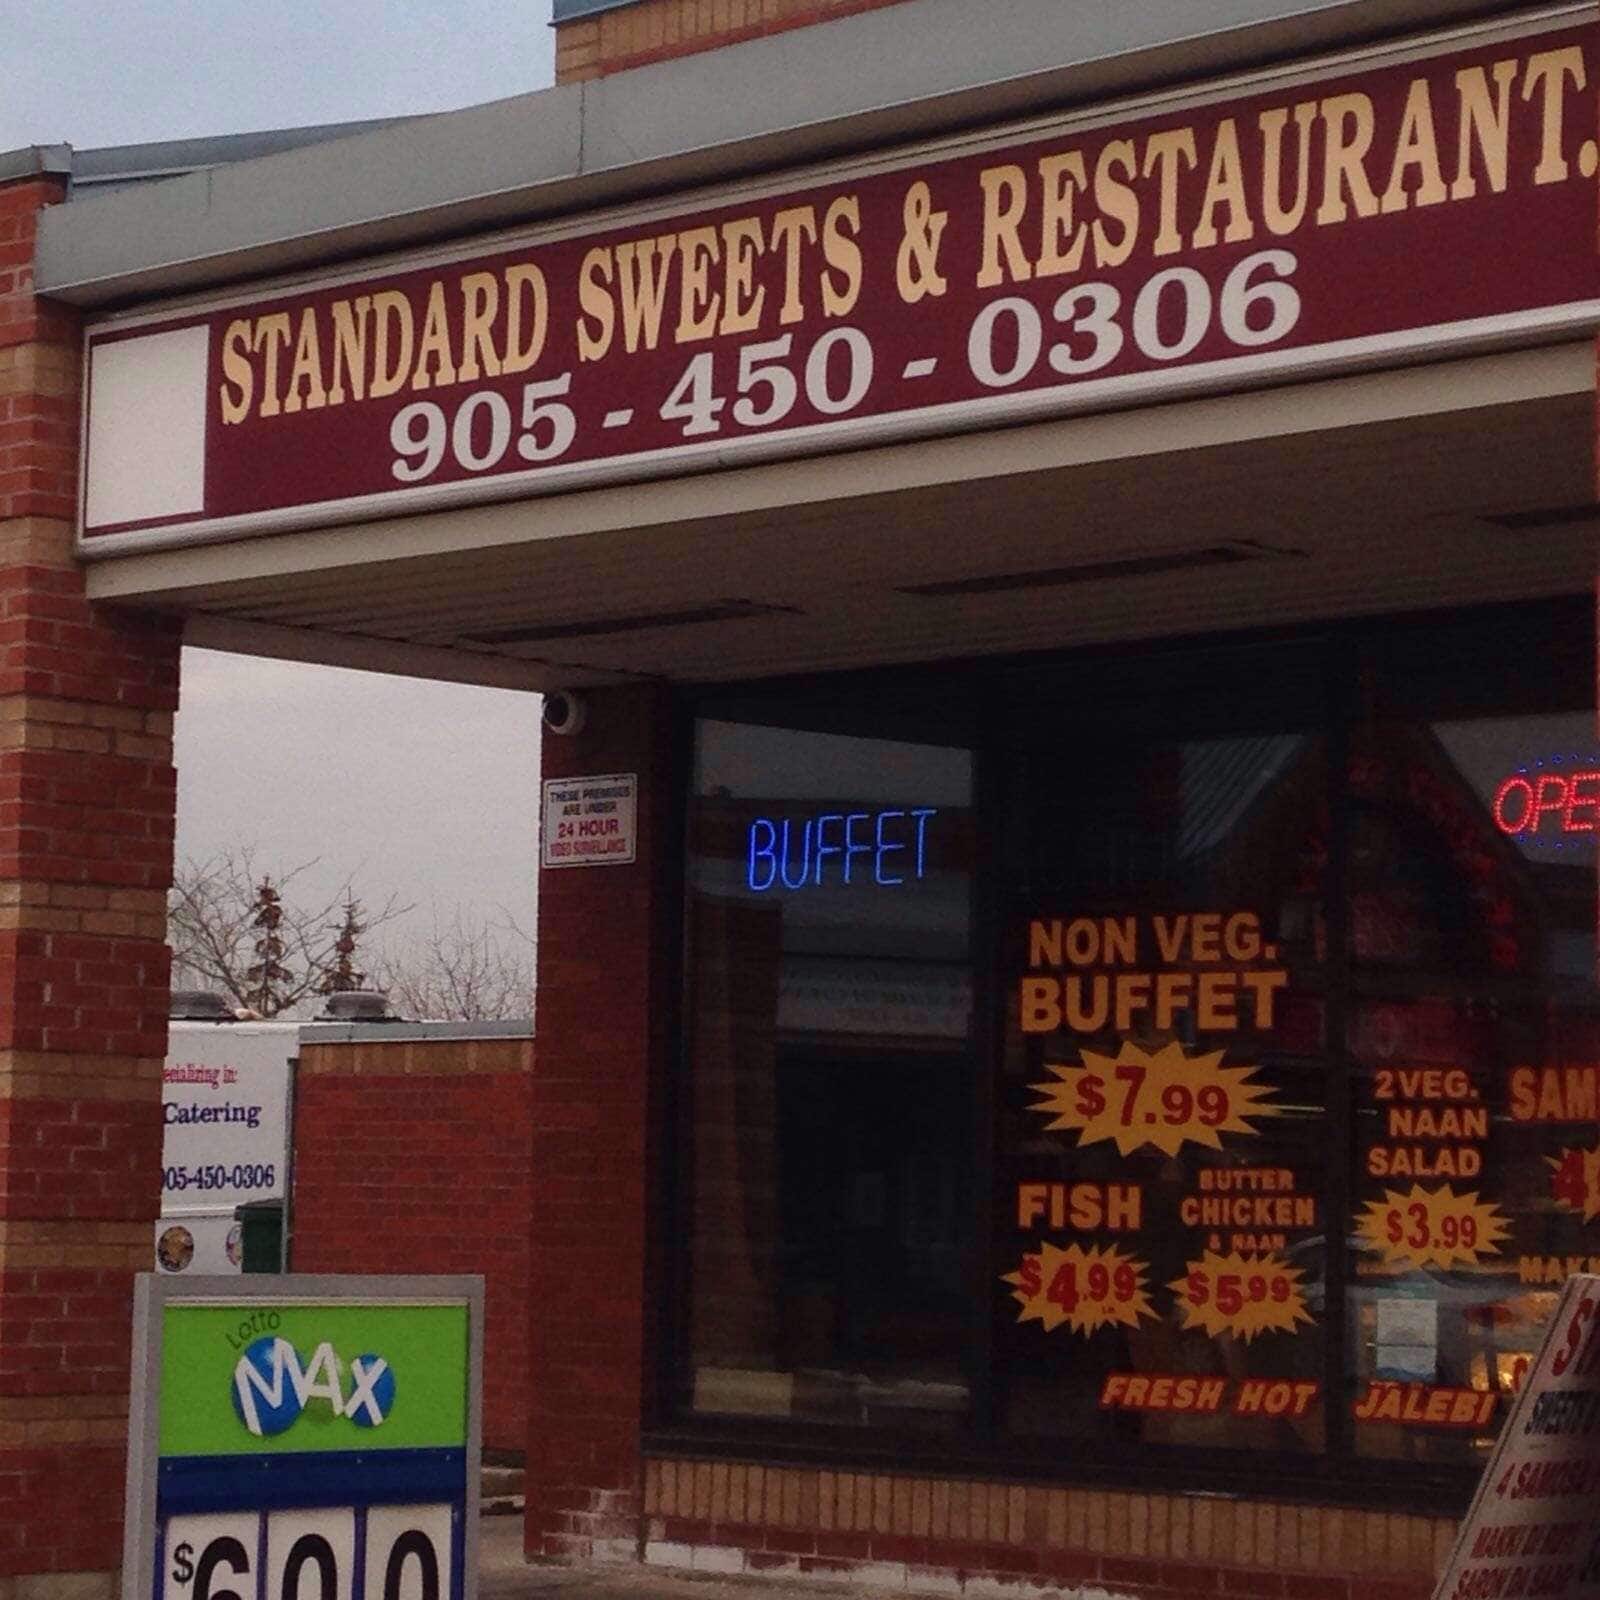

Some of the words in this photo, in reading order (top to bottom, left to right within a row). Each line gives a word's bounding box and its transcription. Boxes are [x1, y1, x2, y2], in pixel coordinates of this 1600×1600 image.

[219, 262, 548, 425] STANDARD
[576, 195, 863, 363] SWEETS
[896, 180, 948, 303] &
[976, 45, 1598, 288] RESTAURANT.
[390, 372, 578, 482] 905
[660, 326, 874, 437] 450
[968, 249, 1301, 388] 0306
[558, 822, 574, 838] 24
[579, 819, 618, 836] HOUR
[748, 809, 938, 891] BUFFET
[1029, 917, 1137, 967] NON
[1154, 911, 1278, 963] VEG.
[1020, 970, 1288, 1032] BUFFET
[163, 1102, 262, 1128] Catering
[1075, 1065, 1229, 1128] $7.99
[1389, 1108, 1488, 1137] NAAN
[1199, 1168, 1294, 1191] BUTTER
[1368, 1147, 1482, 1176] SALAD
[1018, 1184, 1142, 1229] FISH
[1180, 1197, 1315, 1227] CHICKEN
[1386, 1202, 1478, 1249] $3.99
[1018, 1257, 1136, 1314] $4.99
[226, 1311, 282, 1350] Lotto
[1102, 1375, 1226, 1410] FRESH
[1236, 1382, 1318, 1414] HOT
[1355, 1388, 1496, 1425] JALEBI
